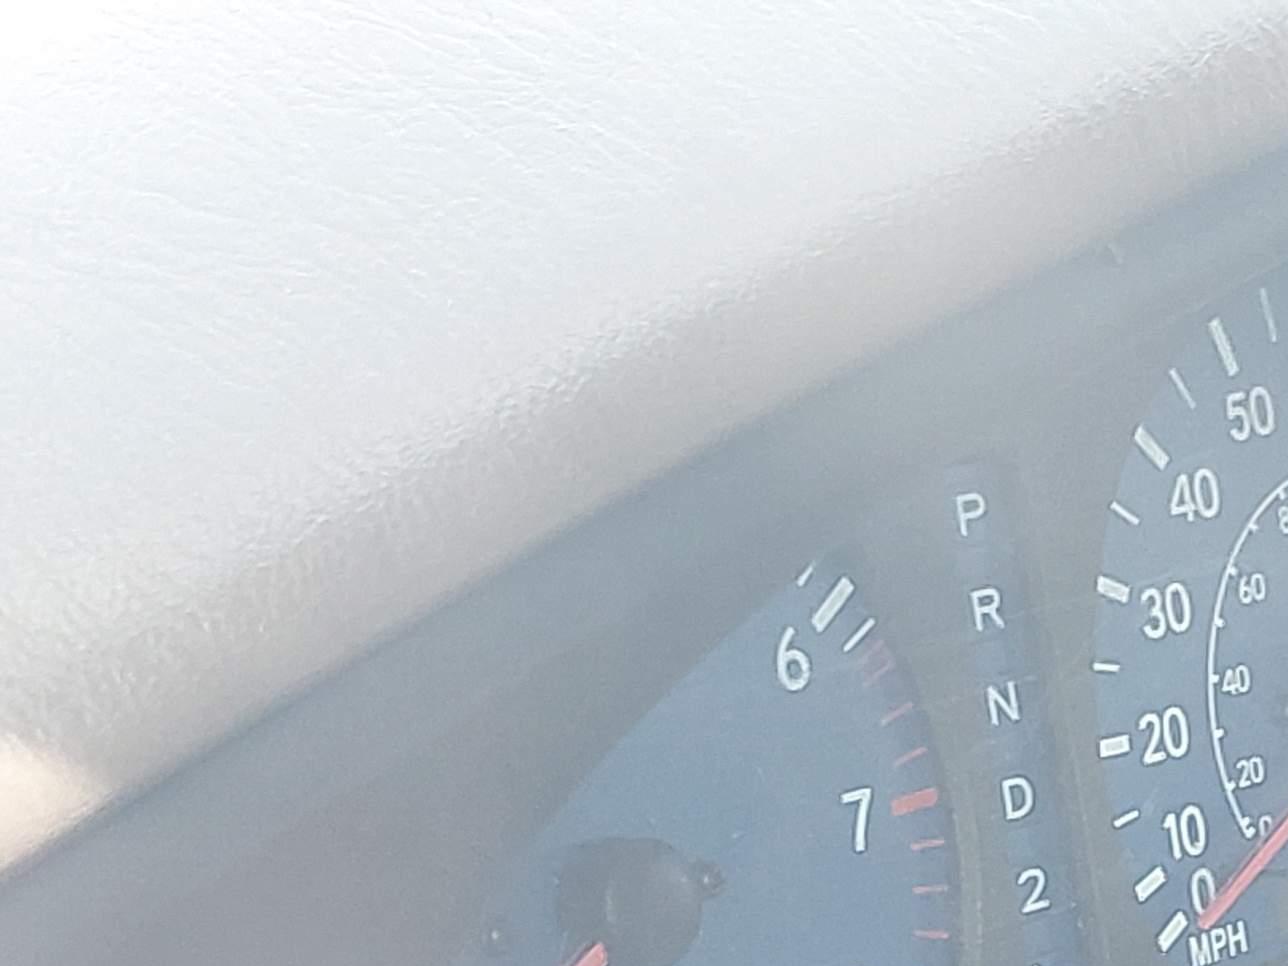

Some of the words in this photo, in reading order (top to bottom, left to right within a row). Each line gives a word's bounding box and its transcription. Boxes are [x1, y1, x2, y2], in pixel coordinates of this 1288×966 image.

[1226, 386, 1276, 441] 50
[956, 493, 985, 537] P
[1170, 468, 1220, 521] 40
[970, 587, 1005, 632] R
[1140, 582, 1192, 640] 30
[1239, 573, 1266, 604] 60
[774, 627, 811, 691] 6
[1221, 664, 1251, 695] 40
[986, 680, 1021, 726] N
[1138, 706, 1190, 766] 20
[1235, 756, 1265, 788] 20
[840, 787, 872, 852] 7
[1001, 776, 1034, 820] D
[1162, 804, 1206, 860] 10
[1017, 868, 1051, 914] 2
[1190, 867, 1217, 917] 0
